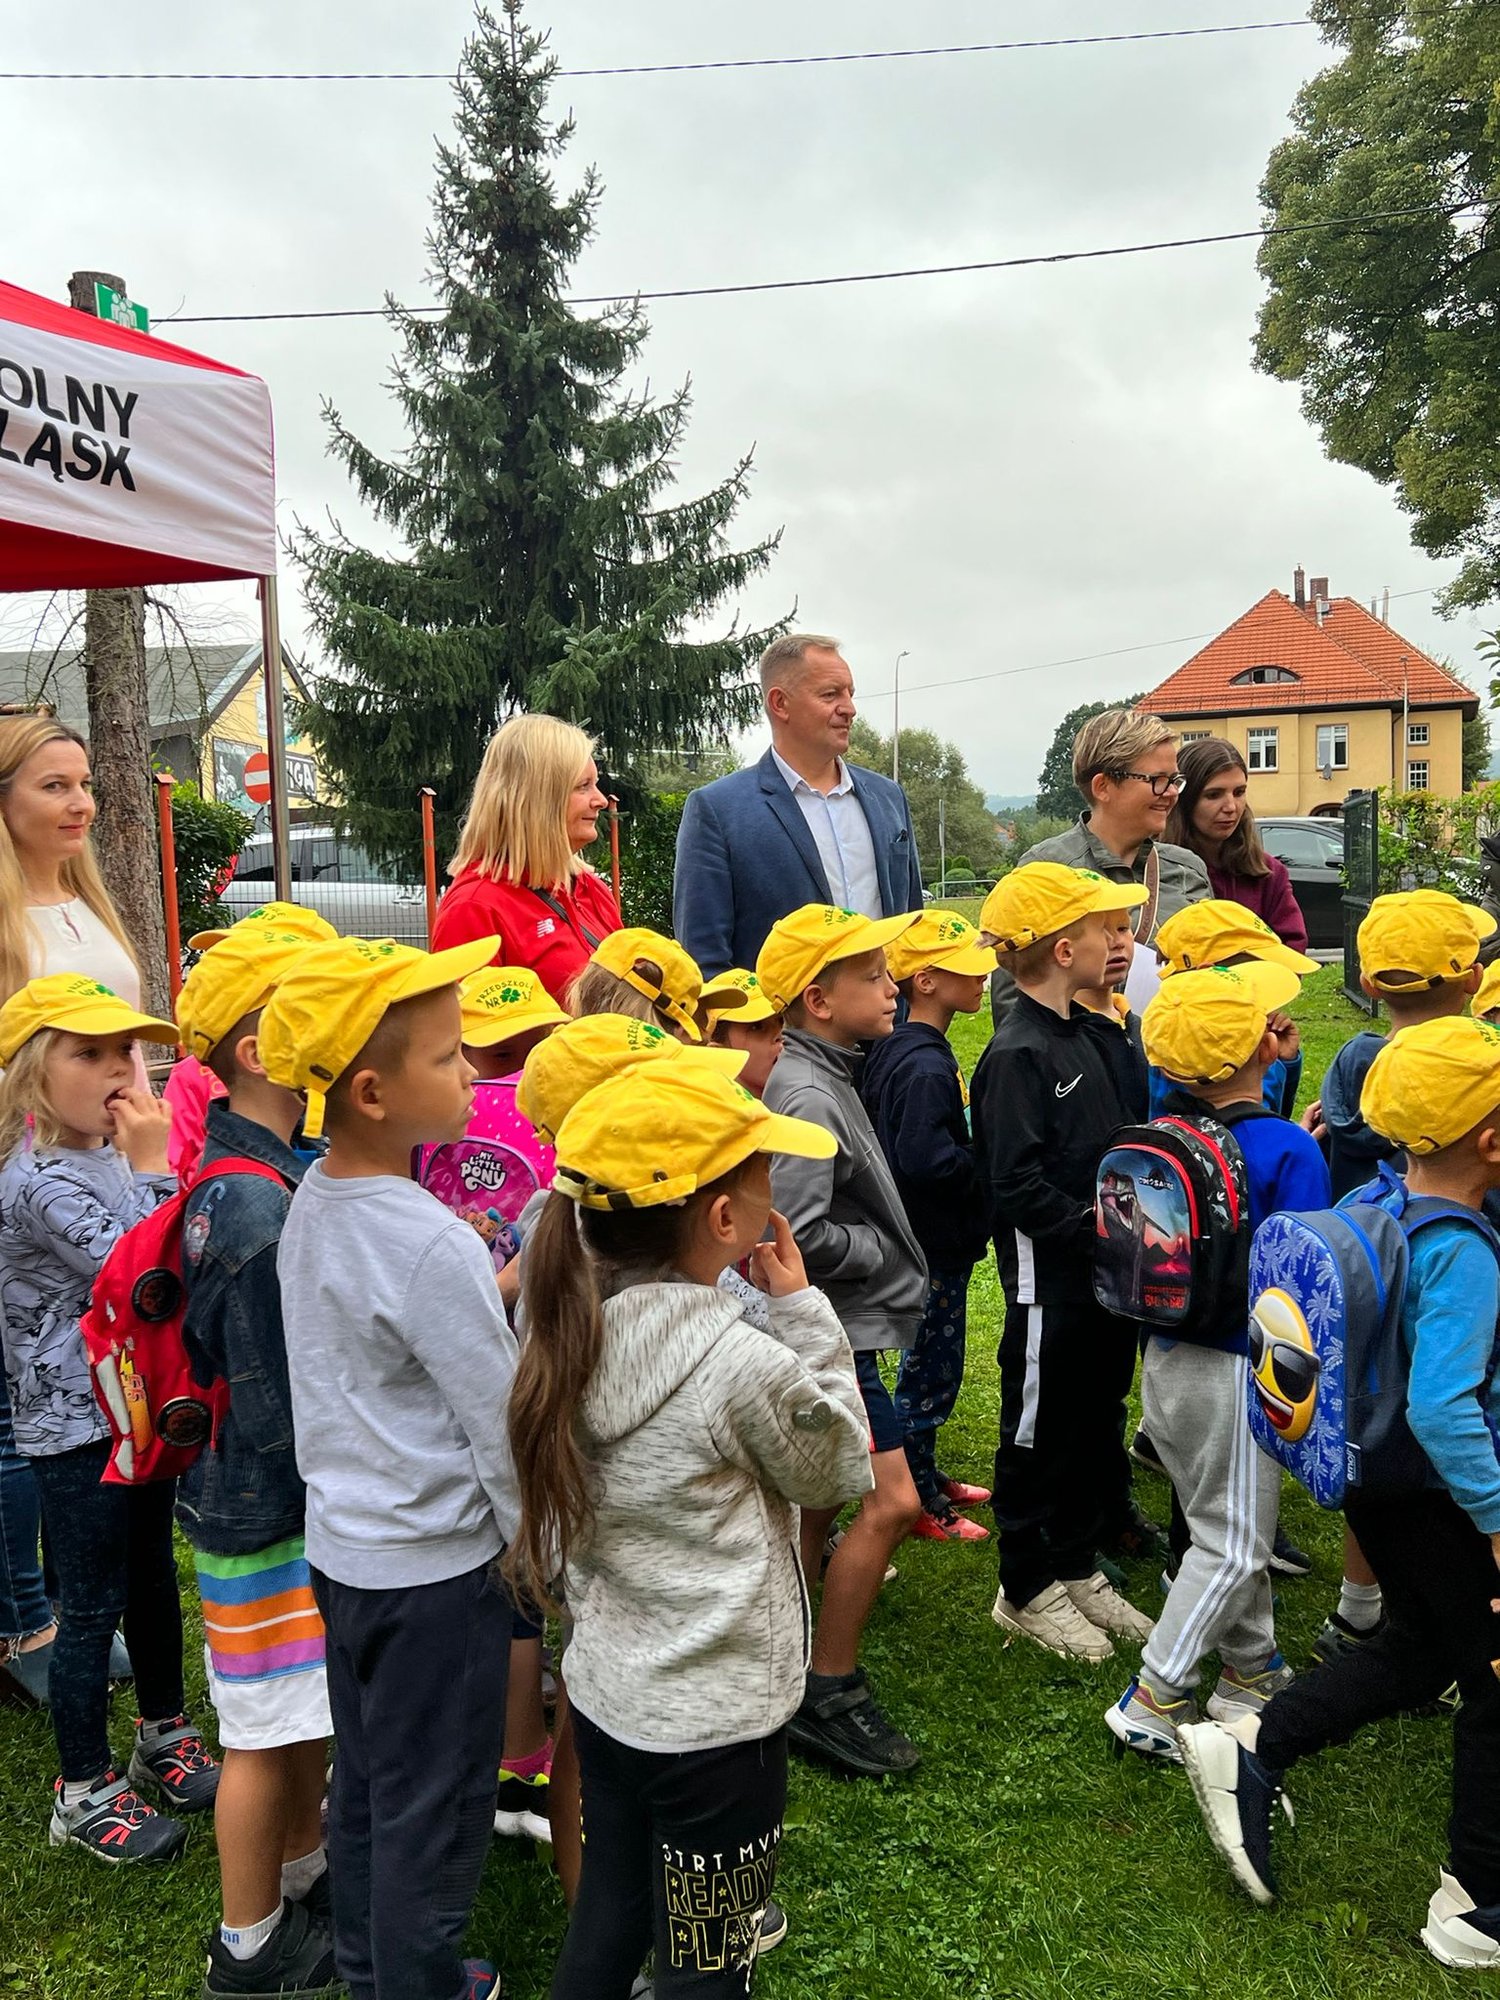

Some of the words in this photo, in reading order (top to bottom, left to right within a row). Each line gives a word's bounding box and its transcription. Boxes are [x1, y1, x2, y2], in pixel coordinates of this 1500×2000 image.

[484, 996, 501, 1010] NR
[480, 1151, 493, 1161] MY
[664, 1849, 774, 1918] READY
